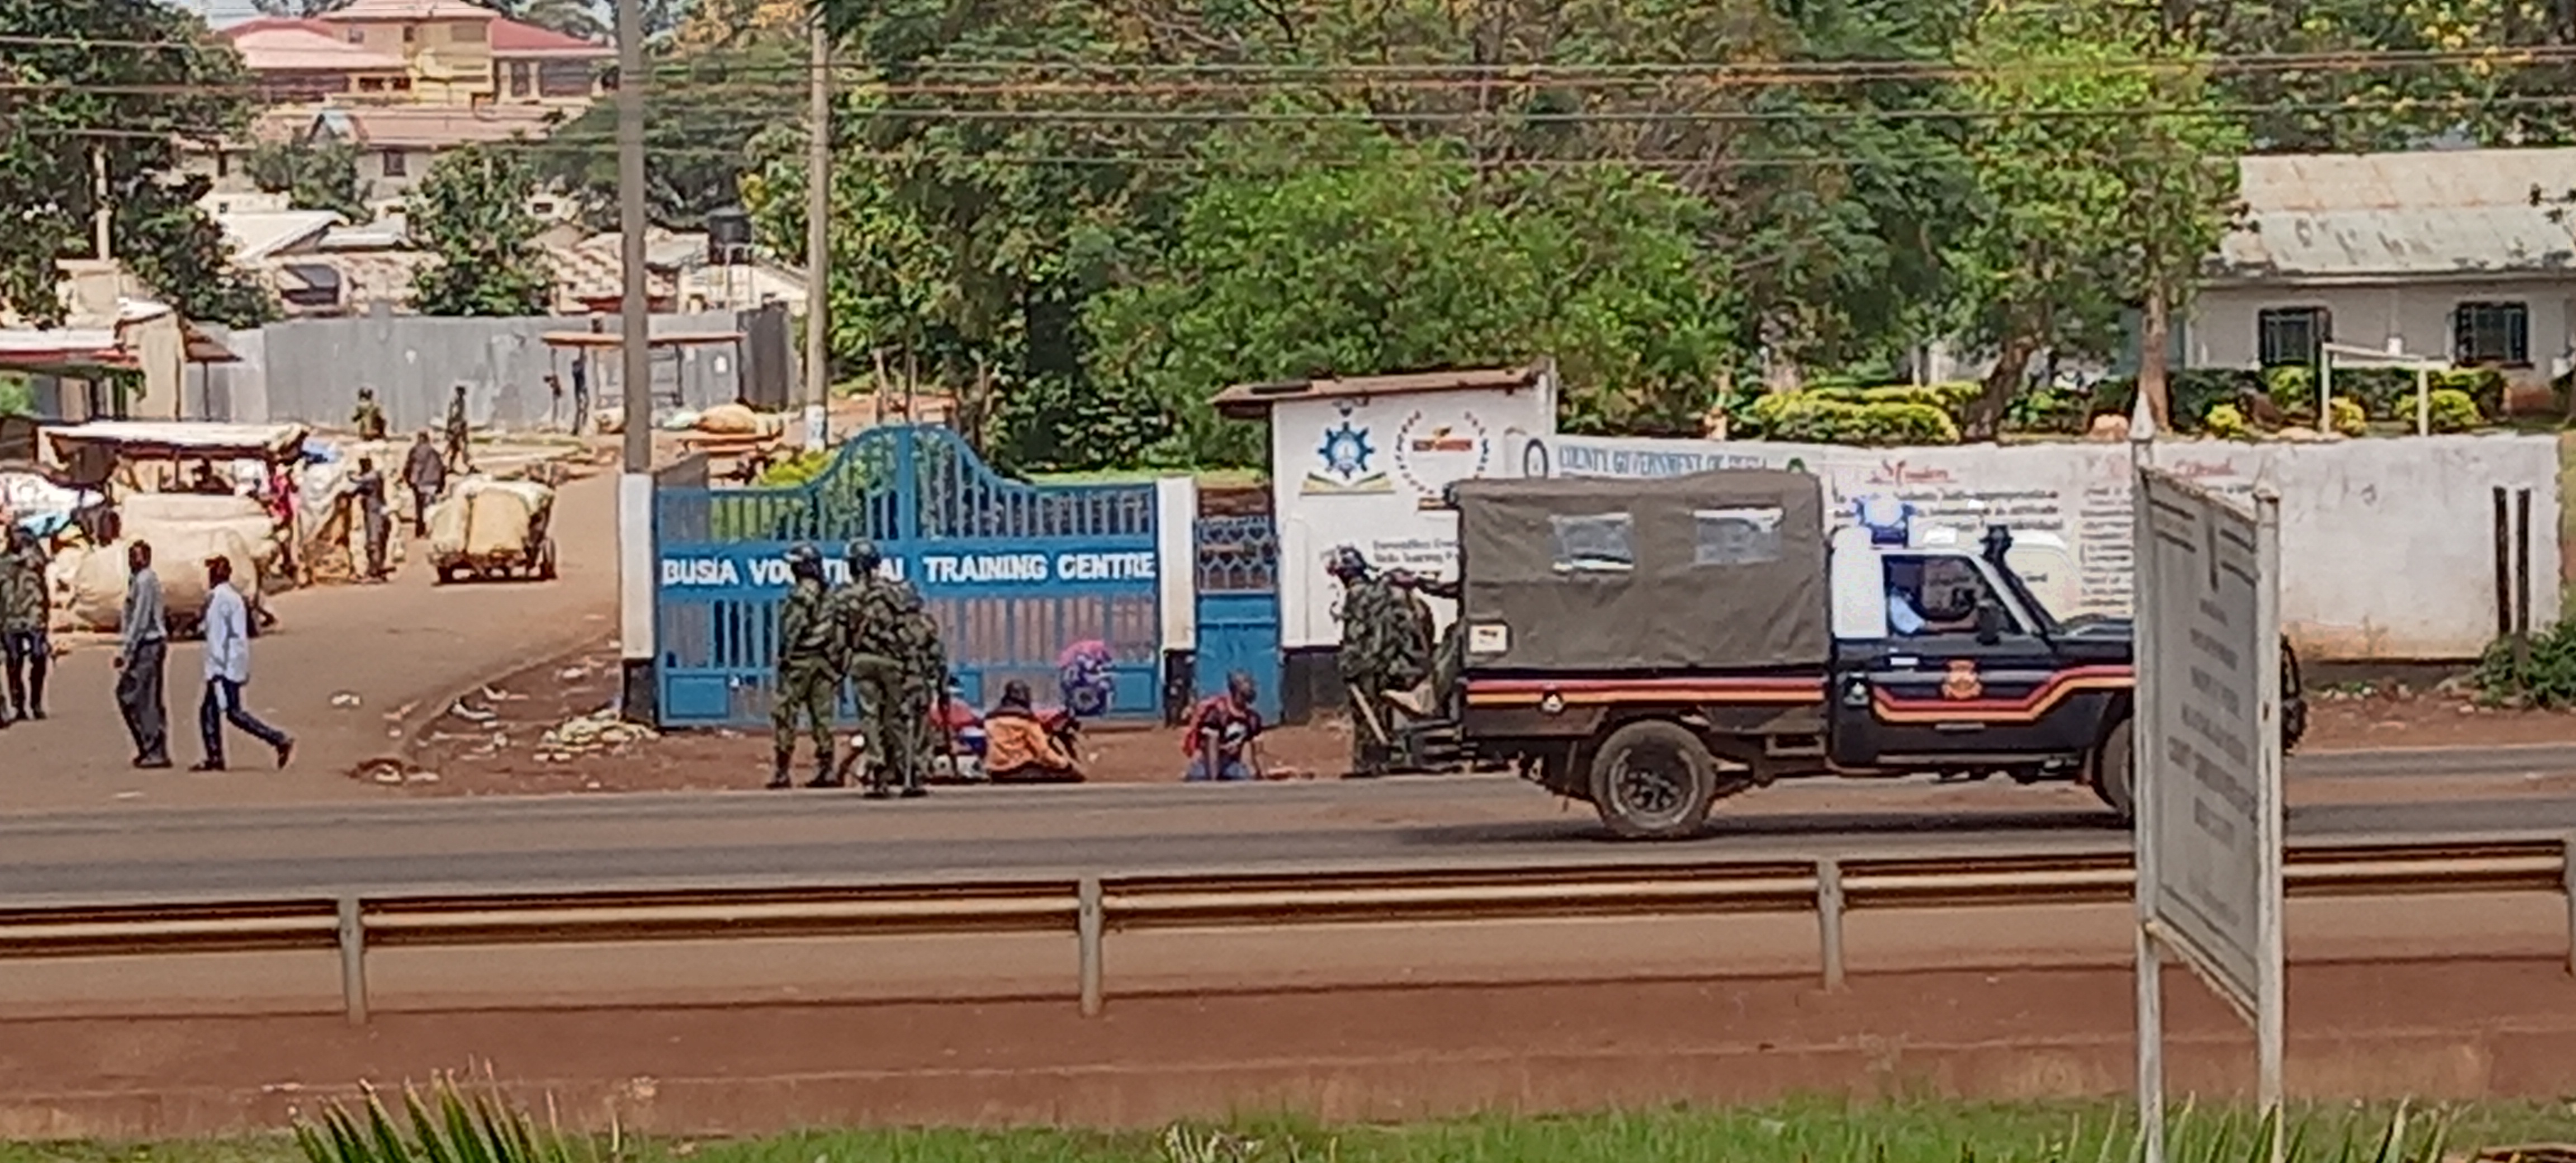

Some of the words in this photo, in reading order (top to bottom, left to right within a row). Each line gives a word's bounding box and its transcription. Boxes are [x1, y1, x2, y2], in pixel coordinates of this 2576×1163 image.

[662, 556, 739, 585] BUSIA
[923, 554, 1049, 582] TRAINING
[1057, 551, 1156, 580] CENTRE
